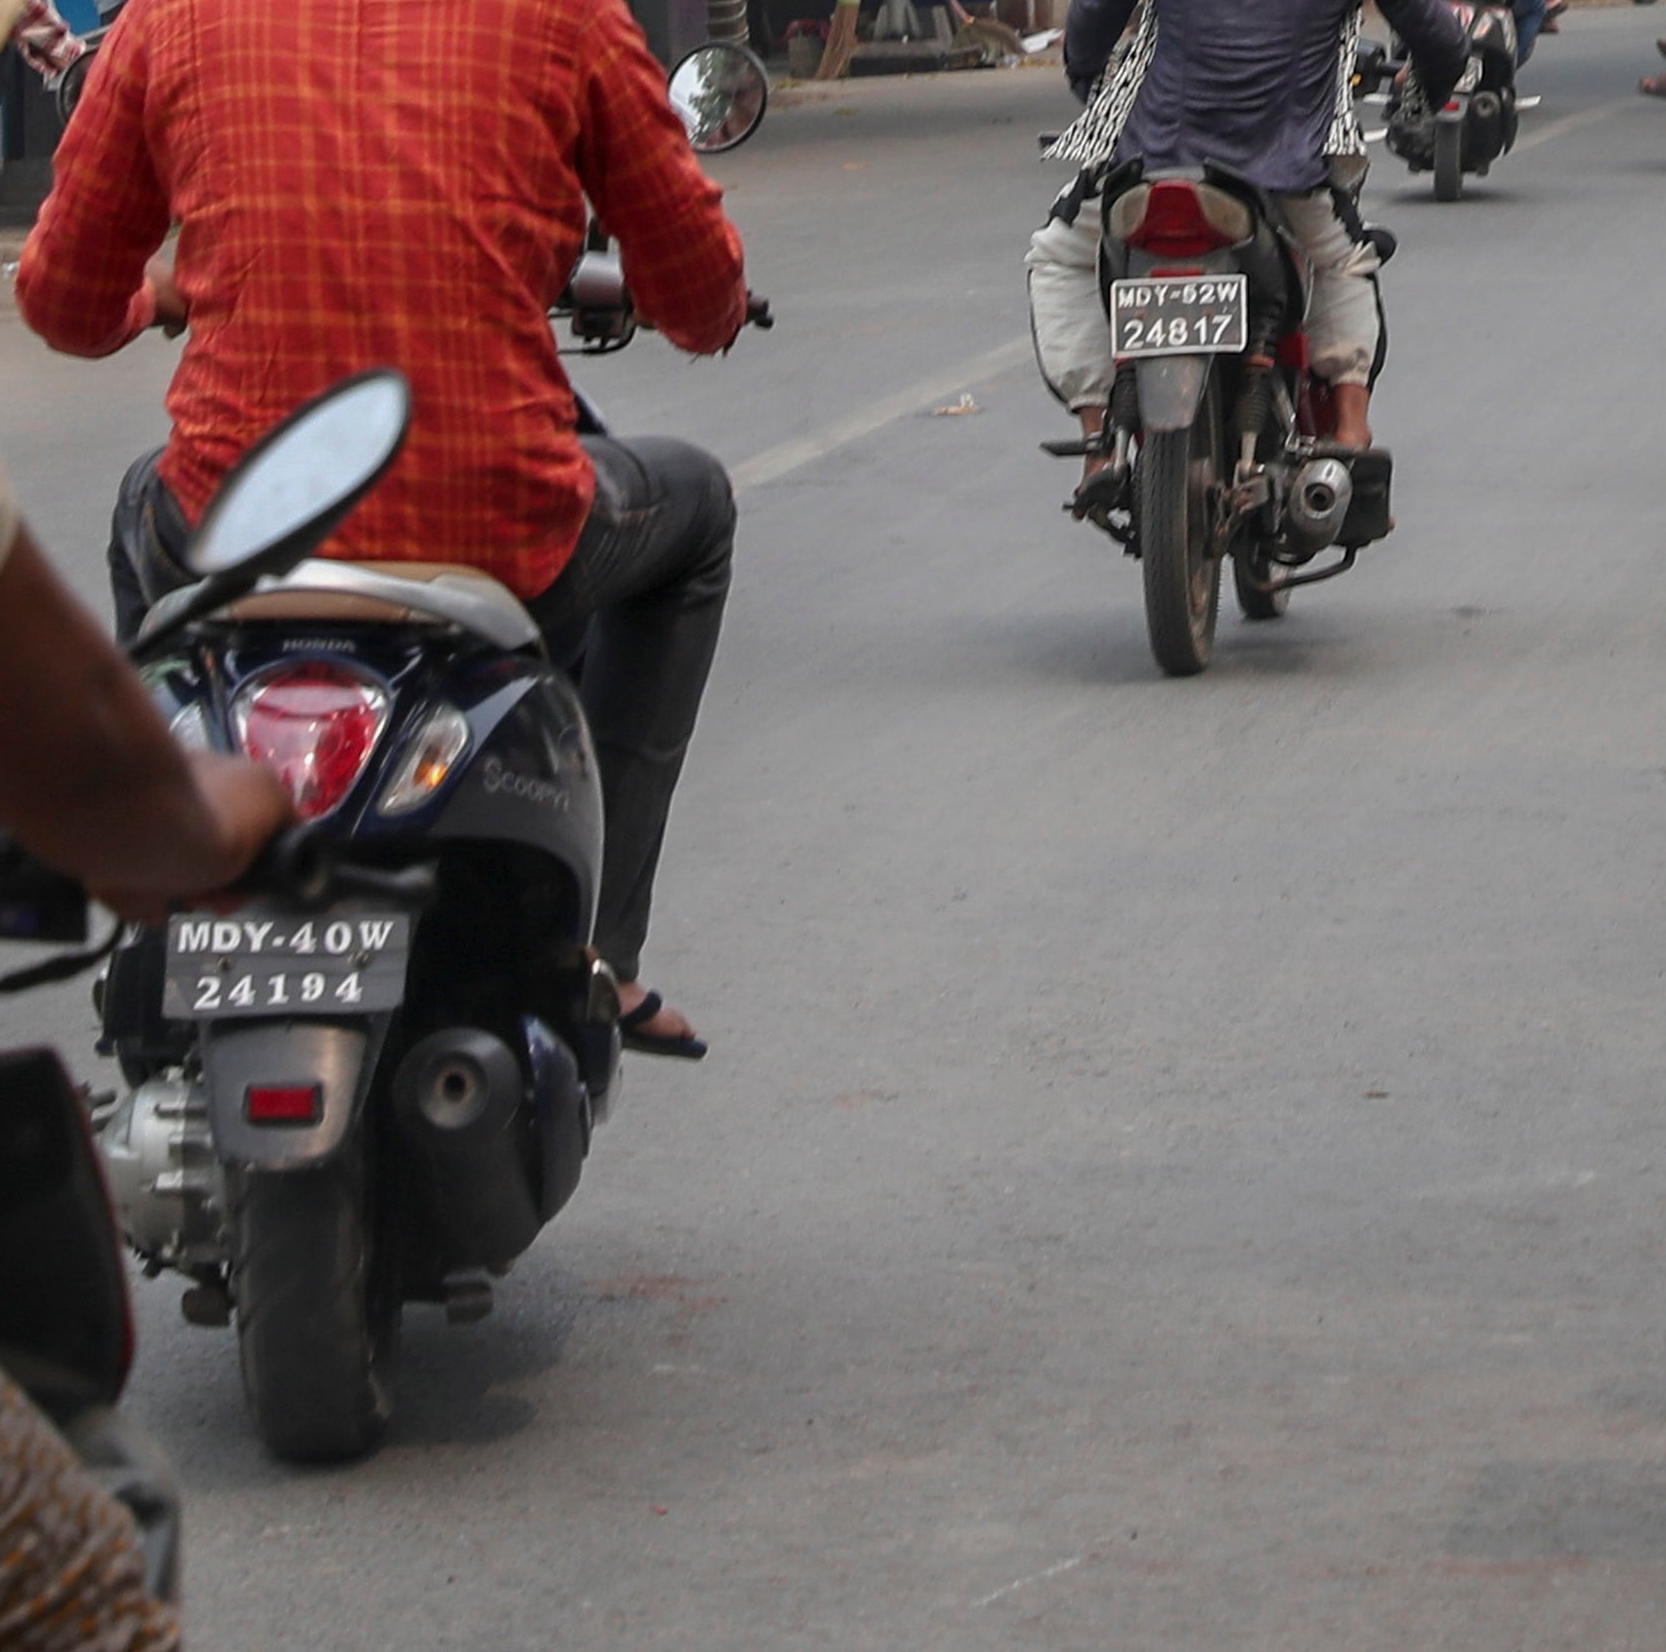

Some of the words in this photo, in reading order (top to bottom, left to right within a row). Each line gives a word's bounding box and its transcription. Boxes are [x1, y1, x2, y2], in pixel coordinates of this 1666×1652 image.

[1124, 314, 1232, 350] 24817
[283, 639, 356, 653] HONDA
[178, 921, 393, 953] MDY-40W
[194, 972, 362, 1010] 24194
